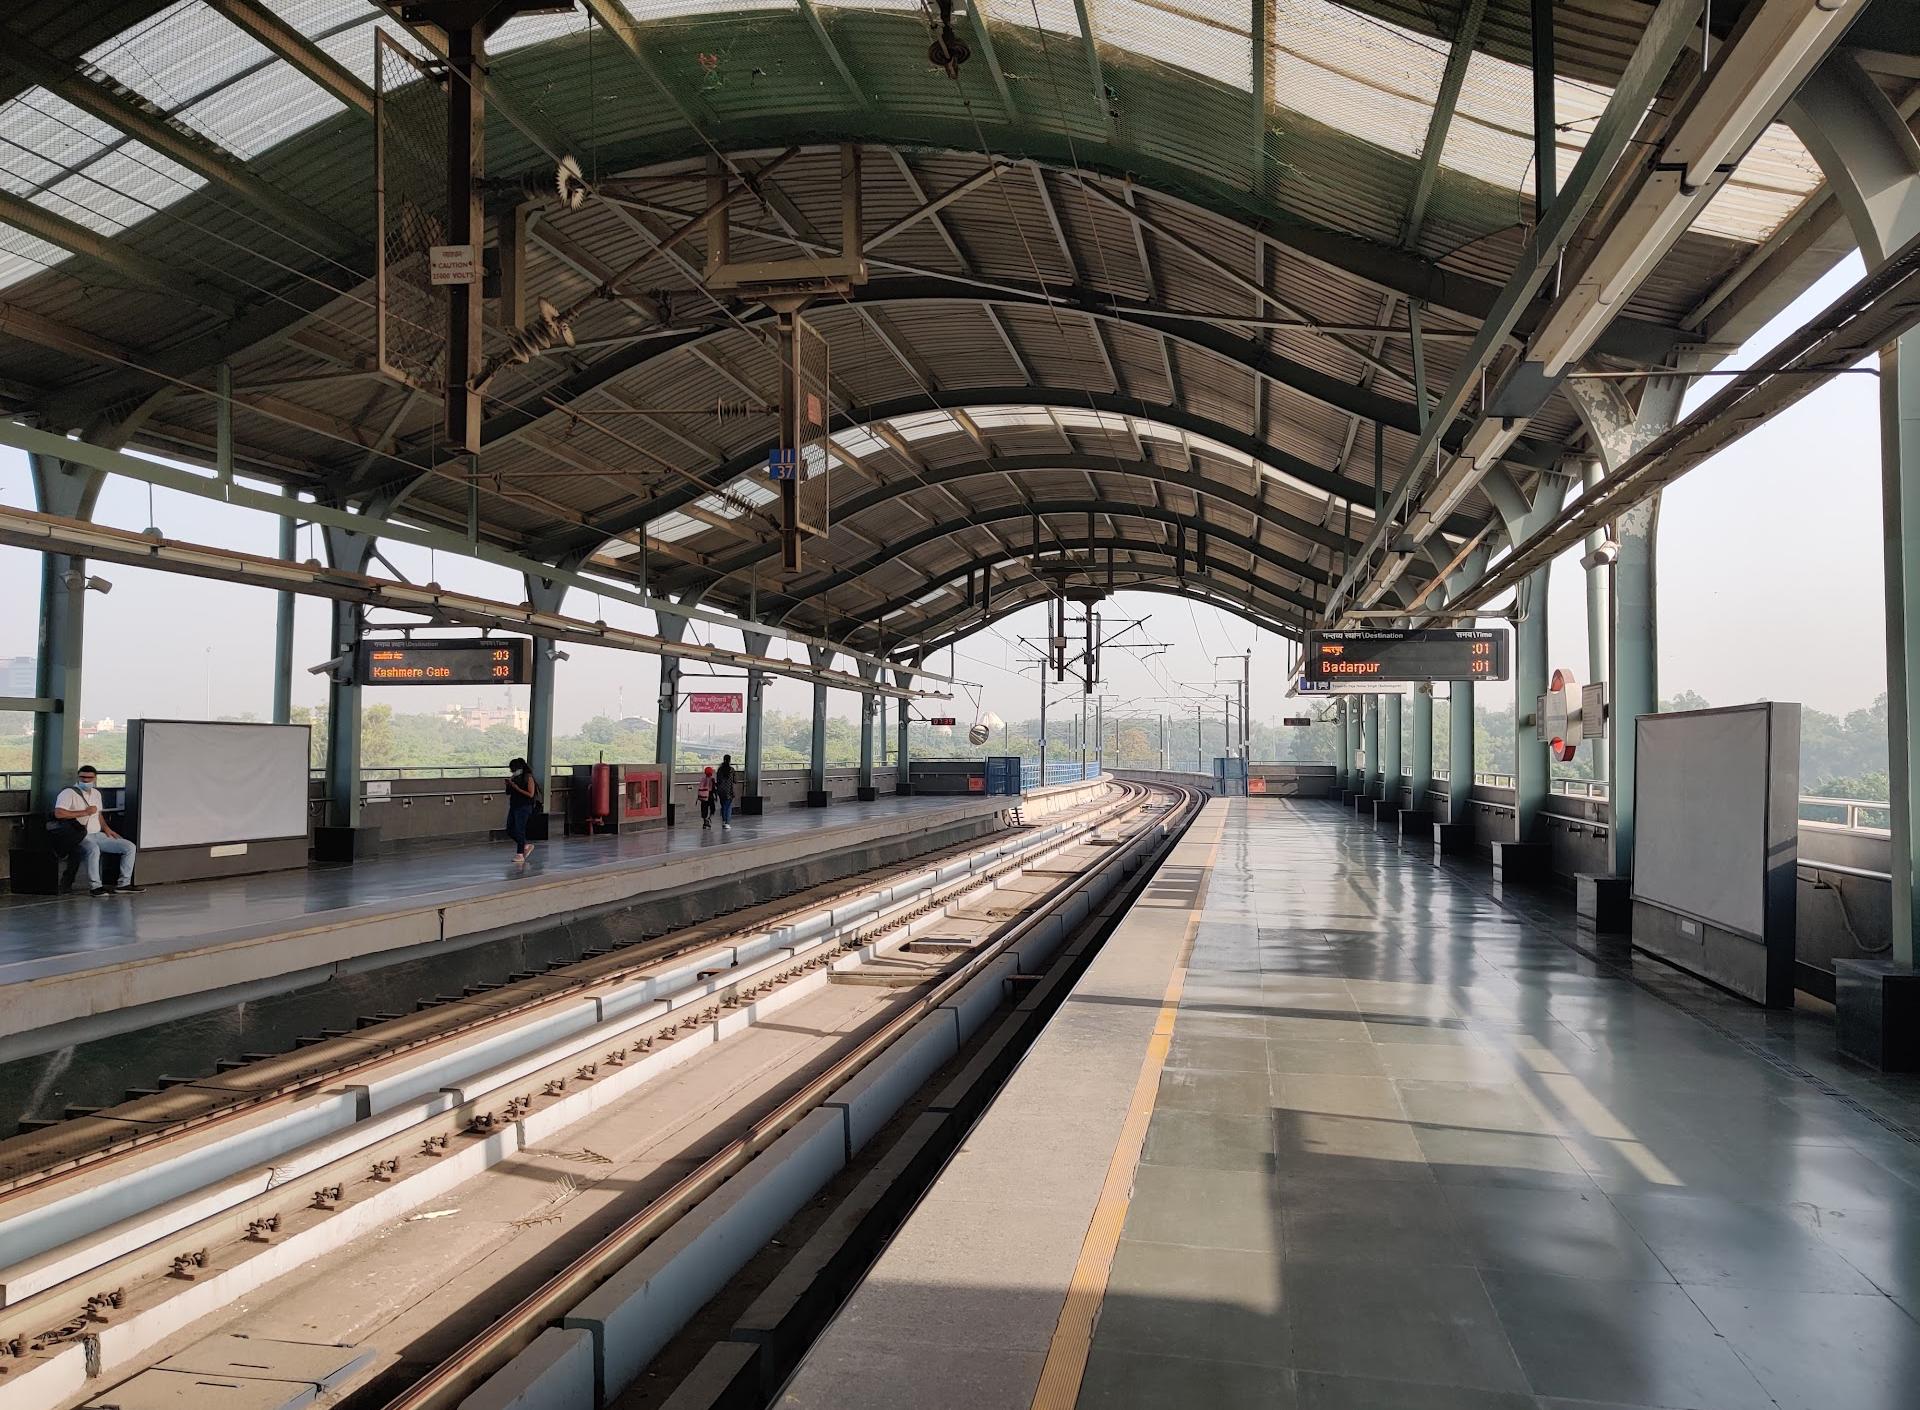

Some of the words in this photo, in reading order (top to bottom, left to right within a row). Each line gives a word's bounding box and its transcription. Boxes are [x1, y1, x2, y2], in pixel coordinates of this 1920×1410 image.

[438, 261, 468, 269] CAUTION
[452, 271, 474, 279] VOLTS
[777, 465, 793, 480] 37
[373, 667, 424, 678] Kashmere
[426, 666, 450, 678] Gate
[1322, 661, 1380, 675] Badarpur
